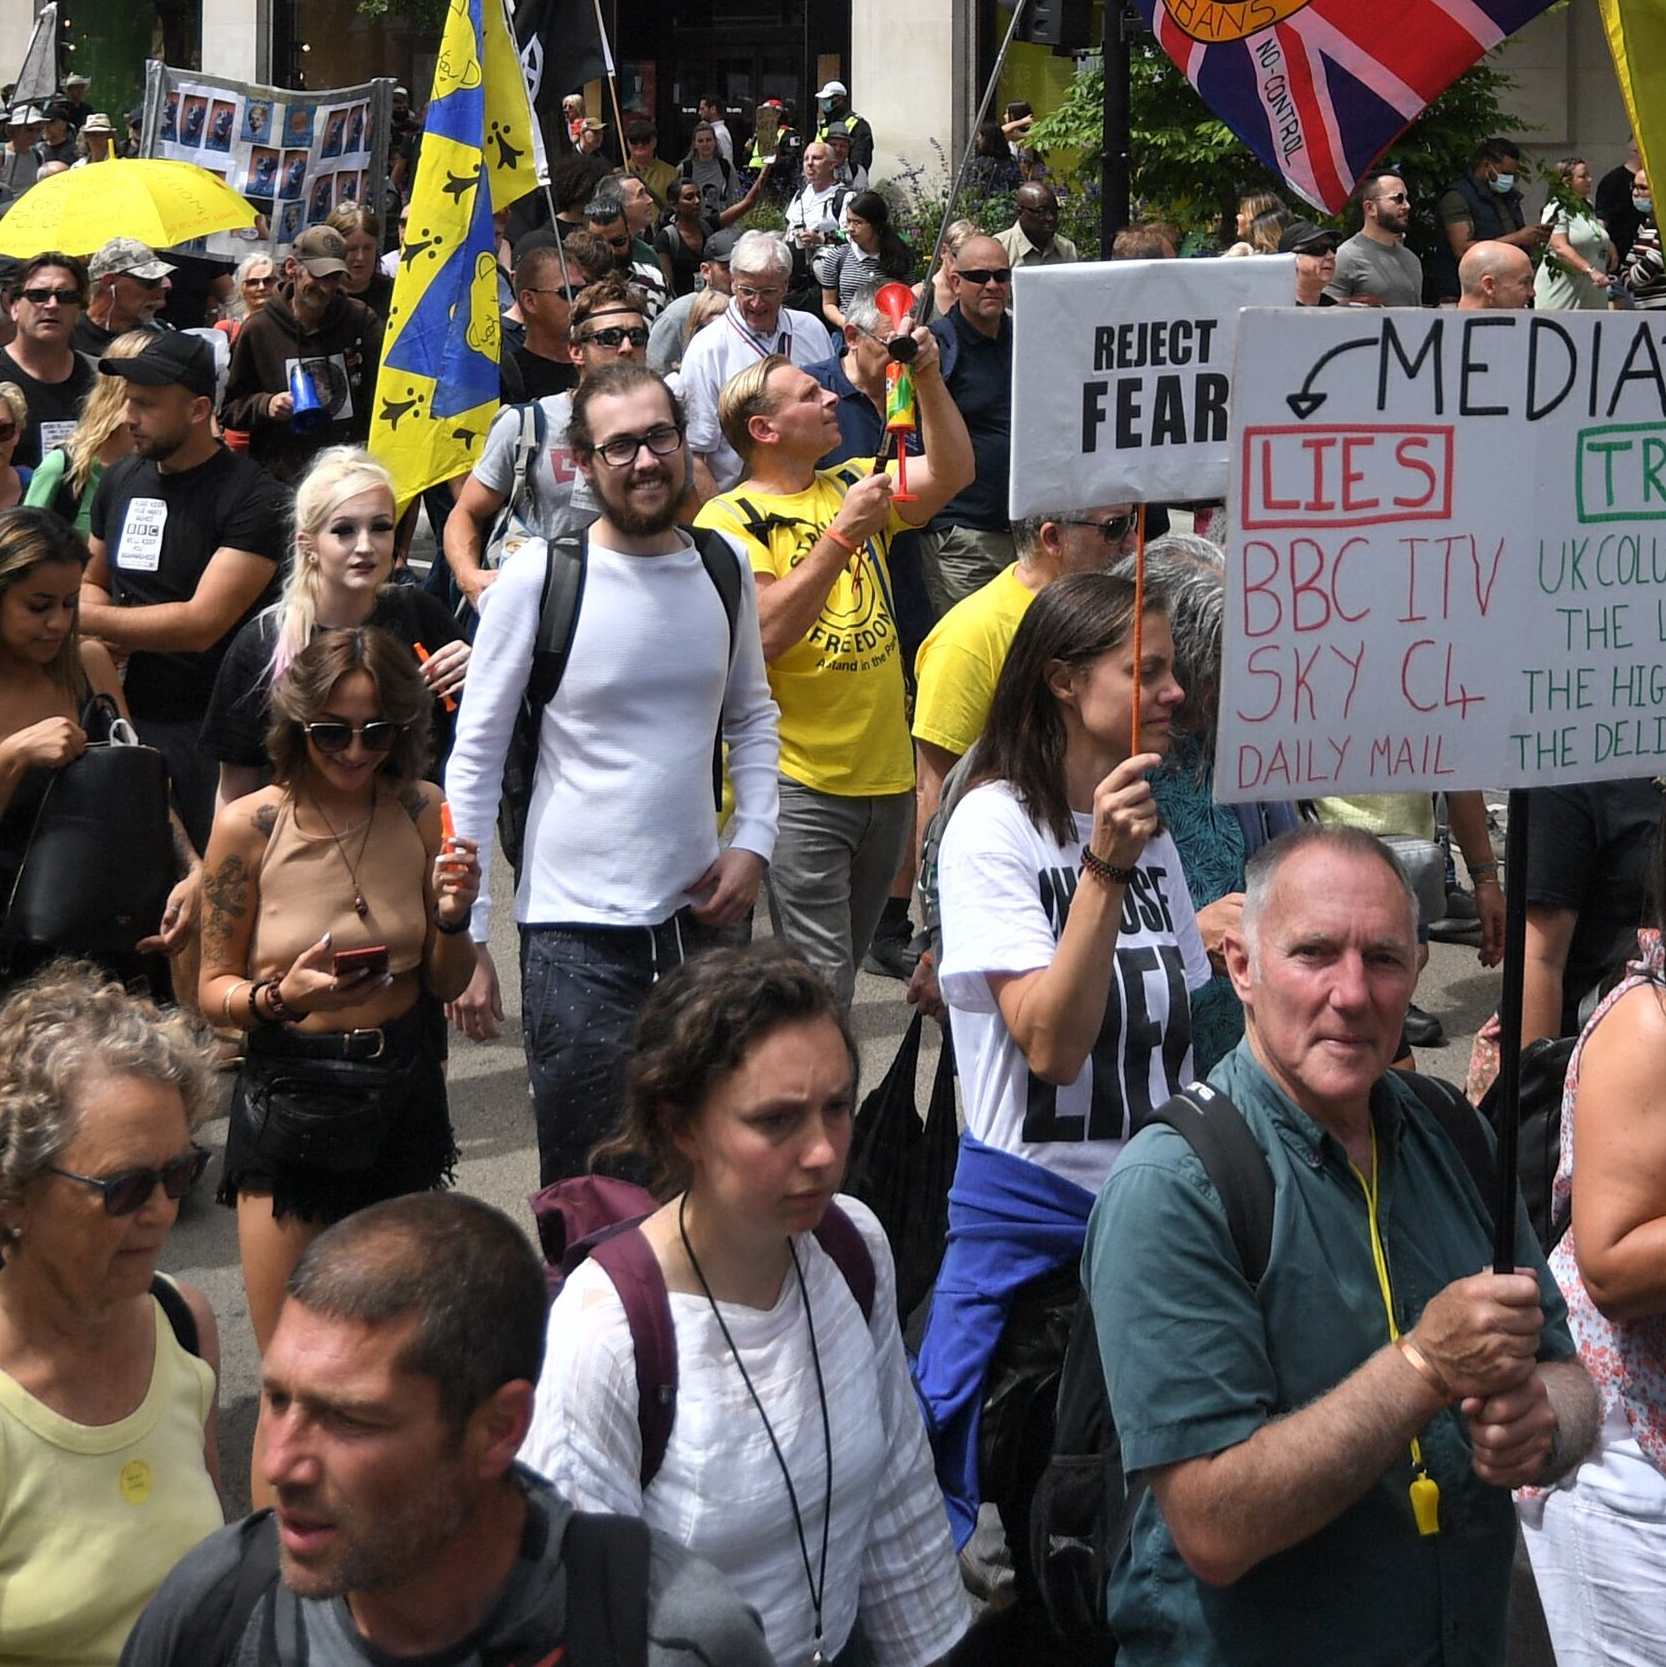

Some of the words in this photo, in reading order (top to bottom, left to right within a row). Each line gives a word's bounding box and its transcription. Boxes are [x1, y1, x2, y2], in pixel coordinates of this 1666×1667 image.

[1093, 319, 1218, 372] REJECT
[1082, 372, 1230, 454] FEAR
[1262, 435, 1436, 511] LIES
[127, 523, 160, 536] BBC
[1243, 536, 1372, 638] BBC
[1397, 534, 1505, 624] ITV
[1537, 535, 1590, 595] UK
[1555, 603, 1634, 652] THE
[826, 660, 858, 672] tand
[861, 659, 871, 671] in
[872, 652, 886, 667] the
[1236, 639, 1366, 724] SKY
[1401, 637, 1487, 720] C4
[1521, 666, 1596, 714] THE
[1237, 733, 1352, 790] DAILY
[1369, 733, 1456, 778] MAIL
[1509, 730, 1579, 772] THE
